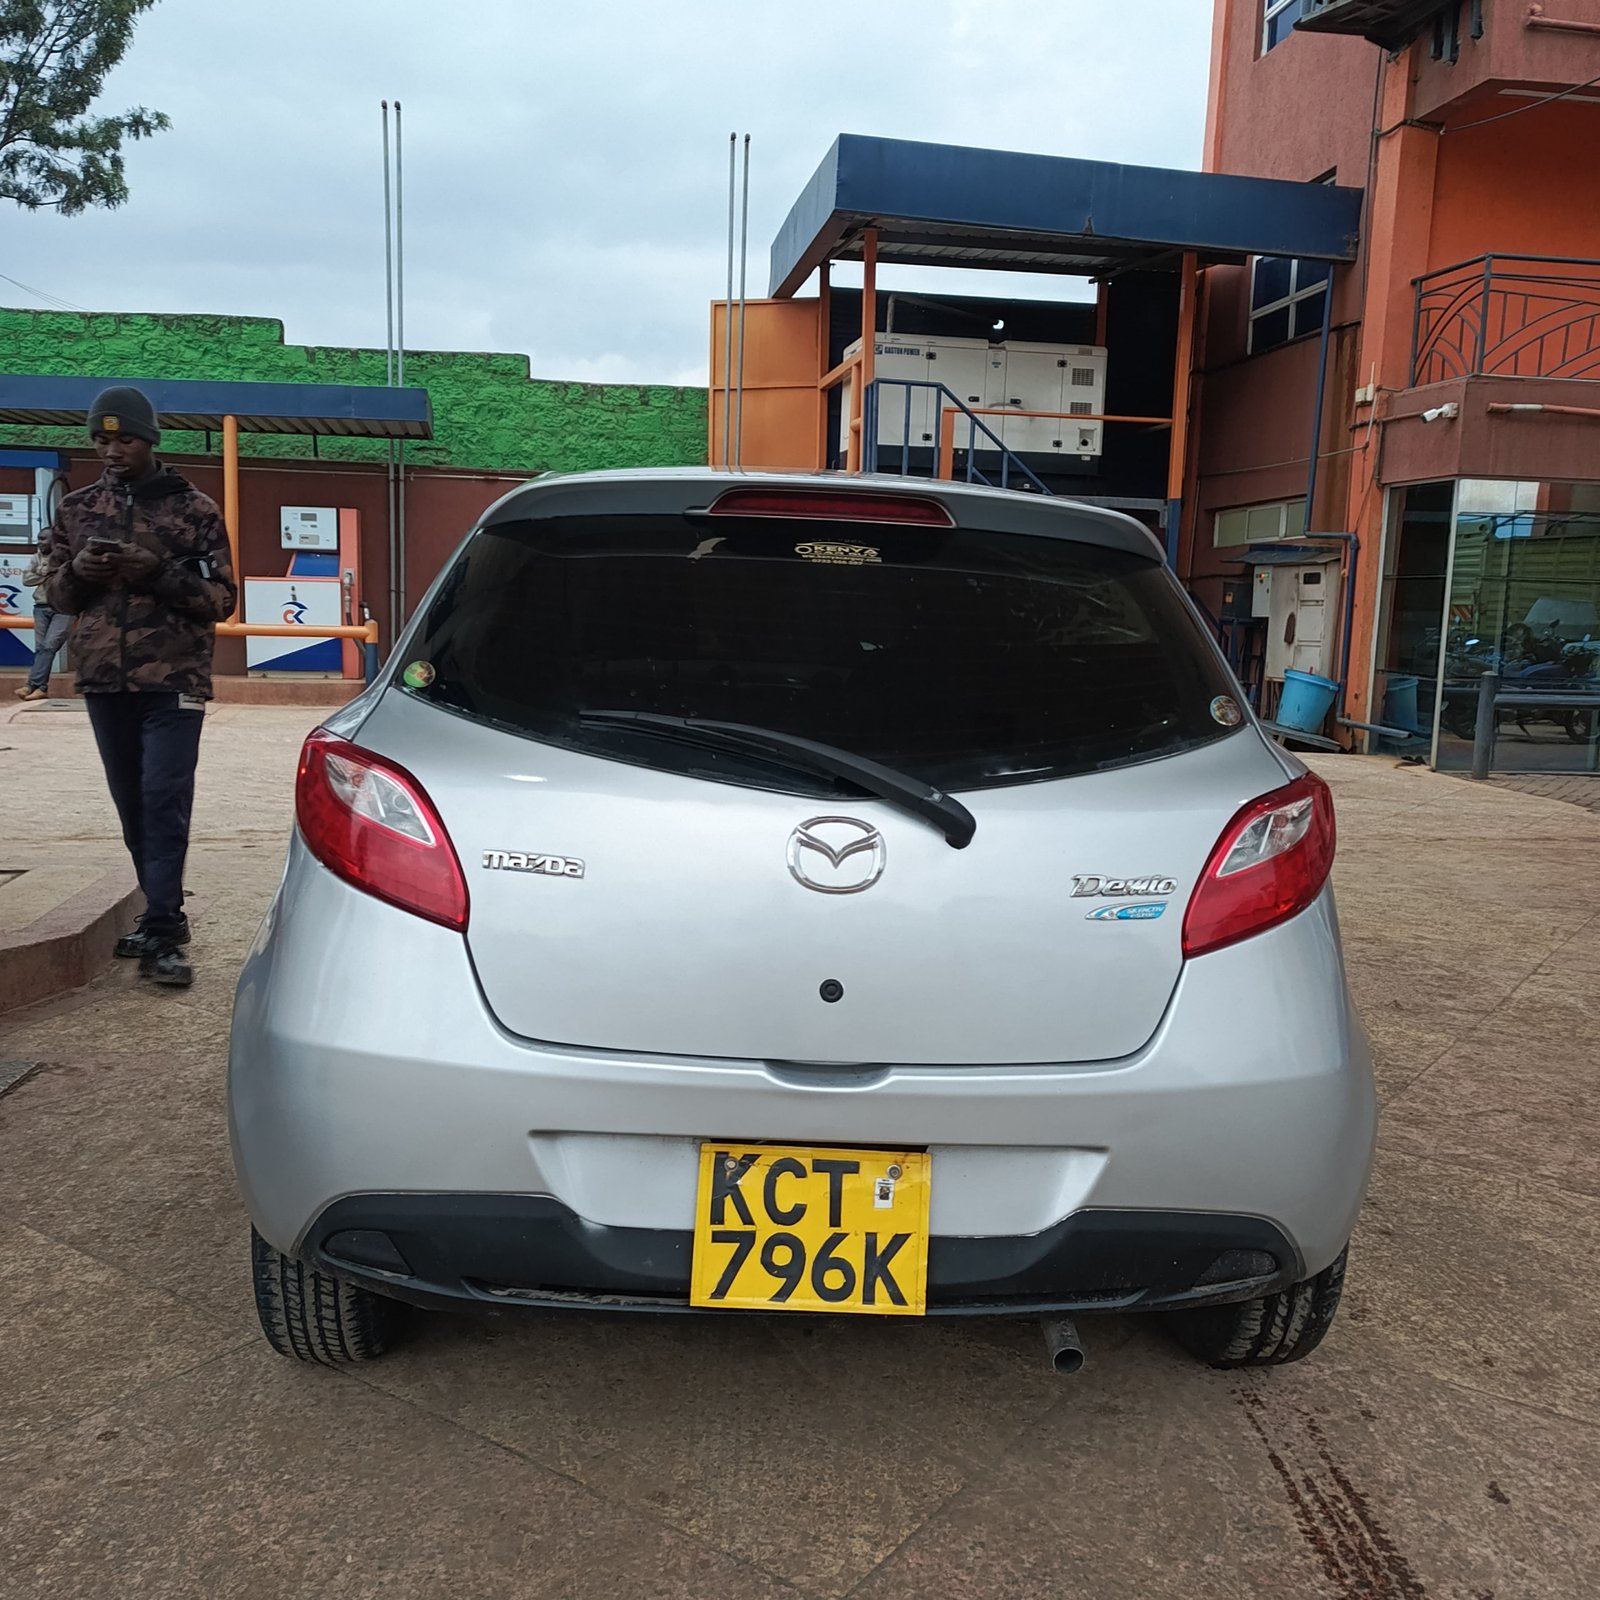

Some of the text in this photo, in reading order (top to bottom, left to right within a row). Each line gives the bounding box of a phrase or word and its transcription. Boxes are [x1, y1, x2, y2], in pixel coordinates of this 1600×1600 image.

[1069, 873, 1179, 897] Demio
[709, 1151, 861, 1228] KCT
[708, 1229, 914, 1307] 796K
